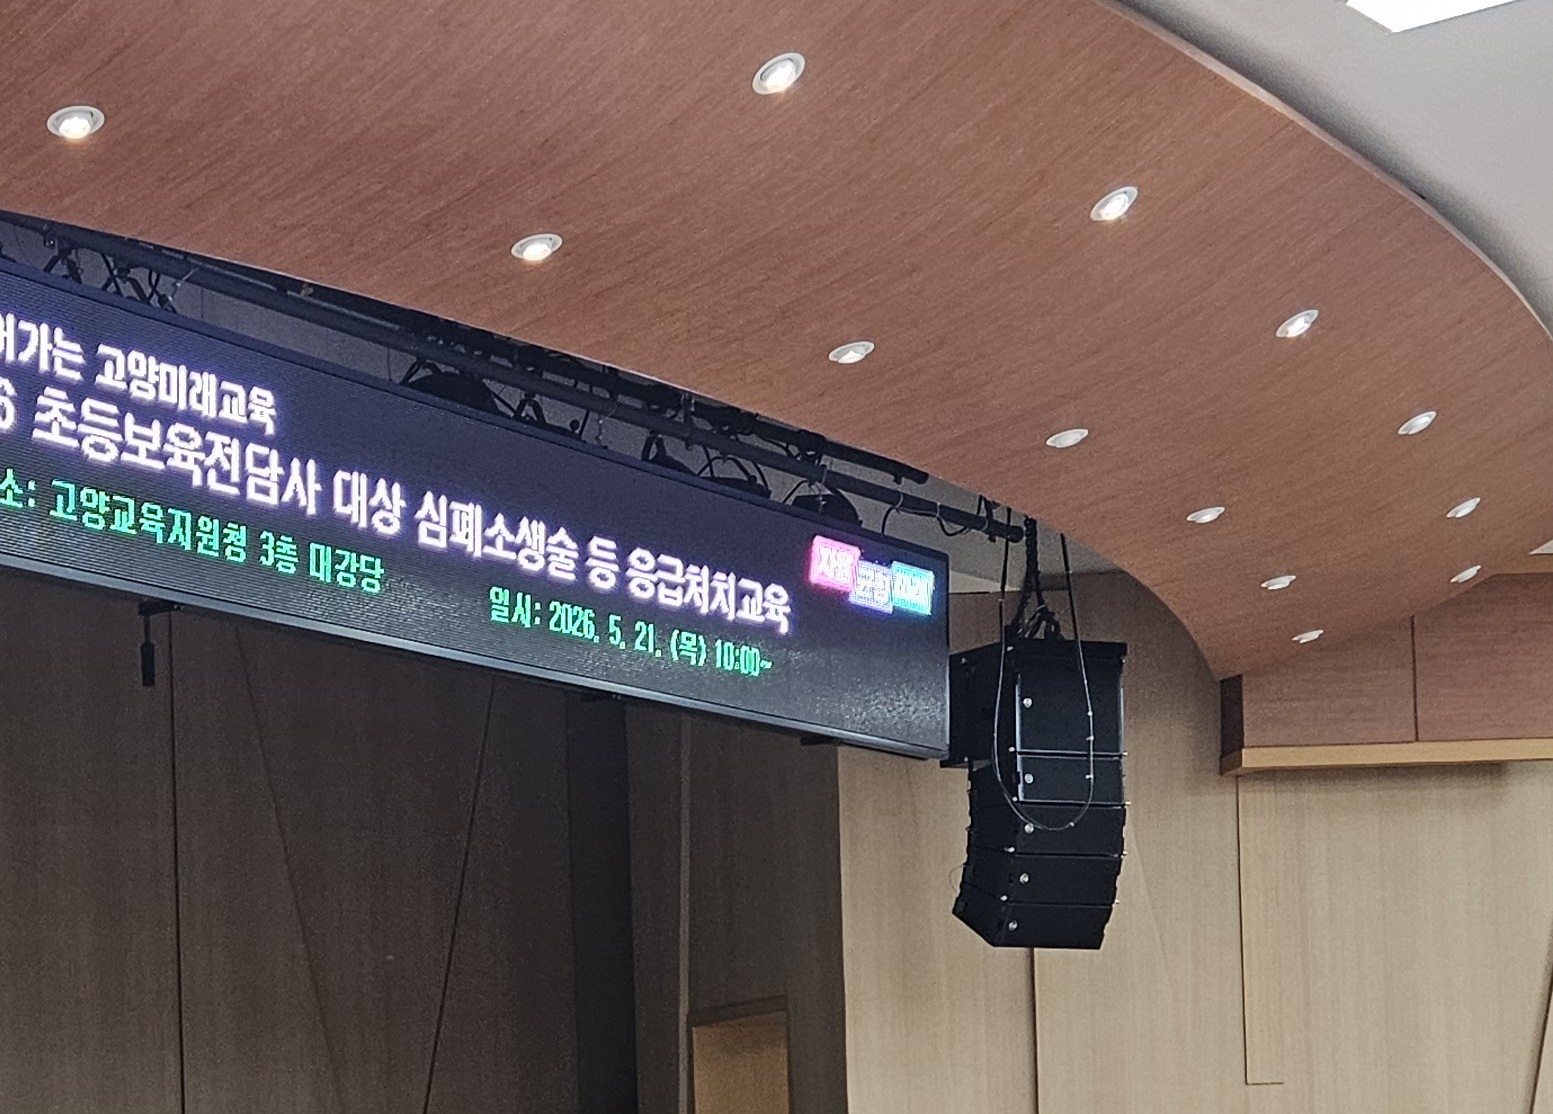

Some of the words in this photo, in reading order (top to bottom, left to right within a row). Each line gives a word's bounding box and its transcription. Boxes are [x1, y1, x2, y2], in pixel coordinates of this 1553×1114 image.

[95, 343, 277, 435] 고양미래교육
[31, 388, 321, 515] 초등보육전담사
[333, 470, 405, 535] 대상
[415, 491, 580, 581] 심폐소생술
[586, 535, 620, 589] 등
[627, 548, 792, 633] 응급처치교육
[49, 481, 247, 563] 고양교육지원청
[258, 531, 299, 574] 3층
[309, 542, 384, 593] 대강당
[489, 587, 541, 628] 일시:
[548, 600, 600, 643] 2026.
[608, 614, 626, 650] 5.
[634, 621, 662, 657] 21.
[670, 630, 707, 667] (목)
